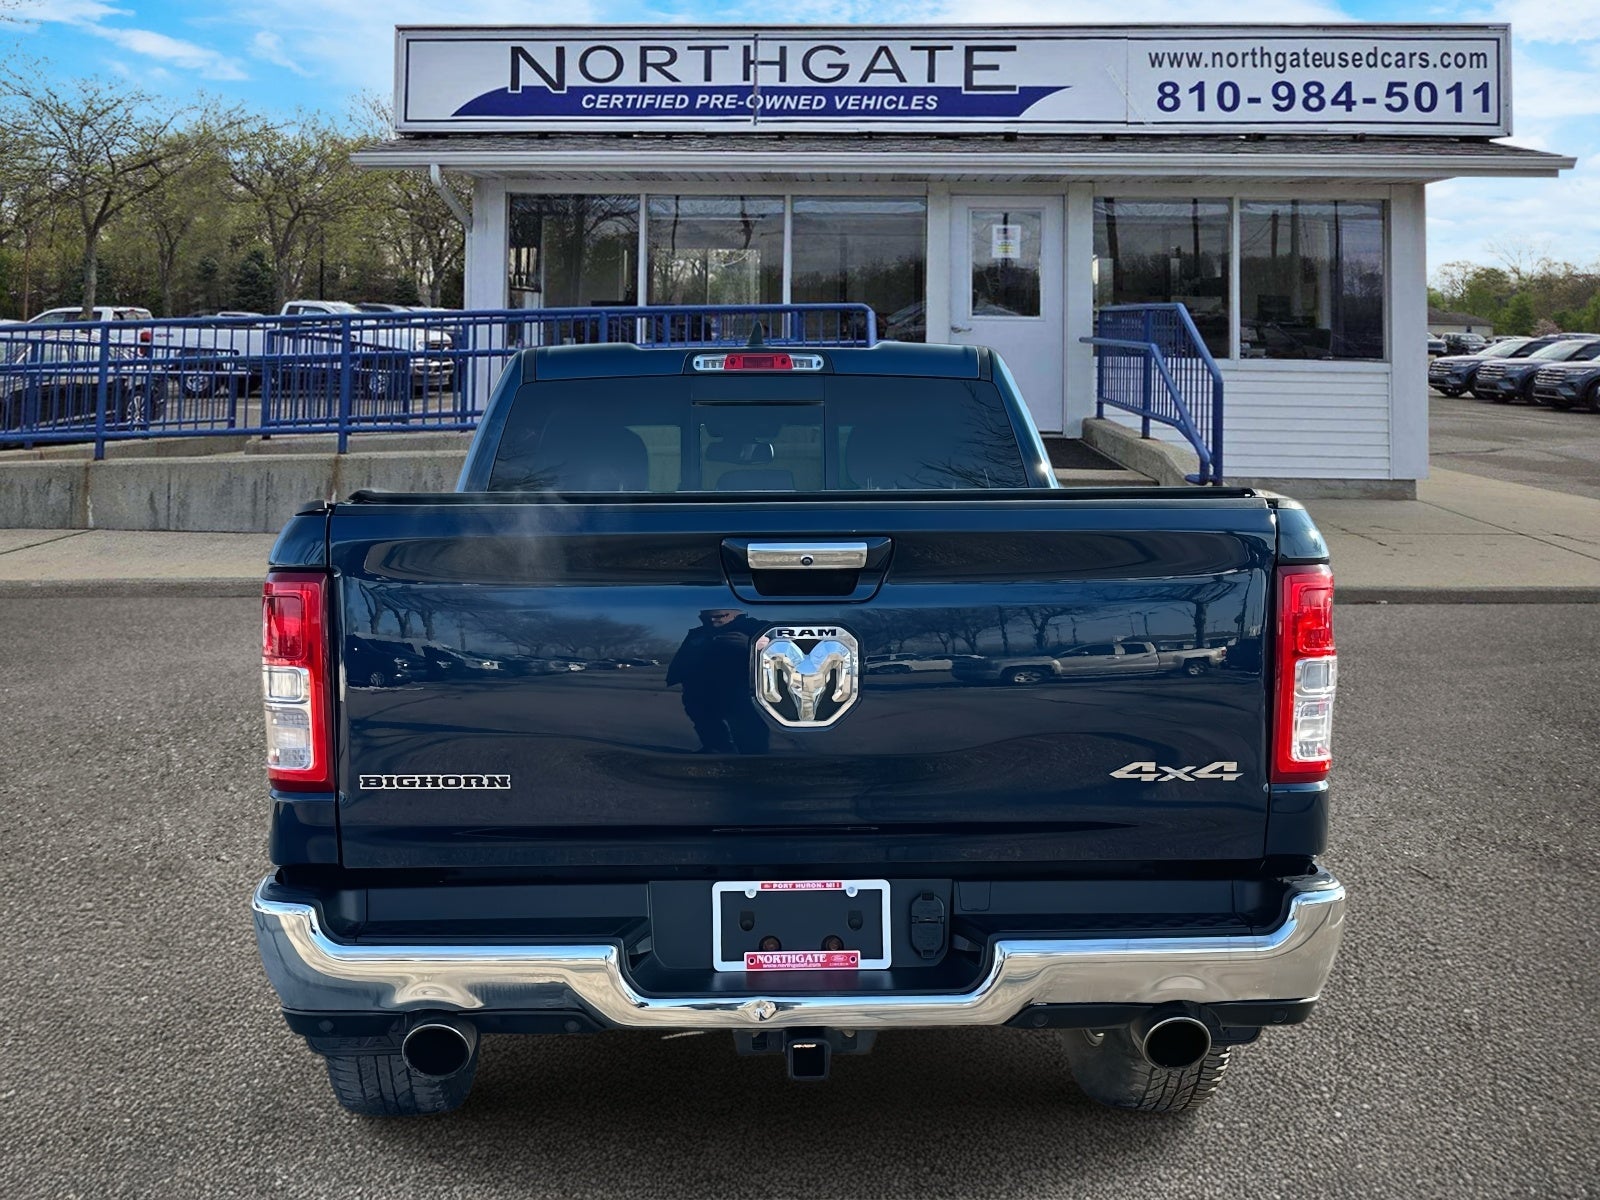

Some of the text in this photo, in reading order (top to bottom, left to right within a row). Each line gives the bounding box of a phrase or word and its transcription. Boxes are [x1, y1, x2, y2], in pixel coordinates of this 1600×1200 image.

[510, 44, 1018, 91] NORTHGATE
[1147, 46, 1489, 74] www.northgateusedcars.com
[581, 94, 940, 110] CERTIFIED PRE-OWNED VEHICLES
[1156, 80, 1492, 114] 810-984-5011
[776, 628, 838, 637] RAM
[1108, 761, 1245, 782] 4x4
[359, 774, 512, 790] BIGHORN
[756, 954, 827, 963] NORTHGATE
